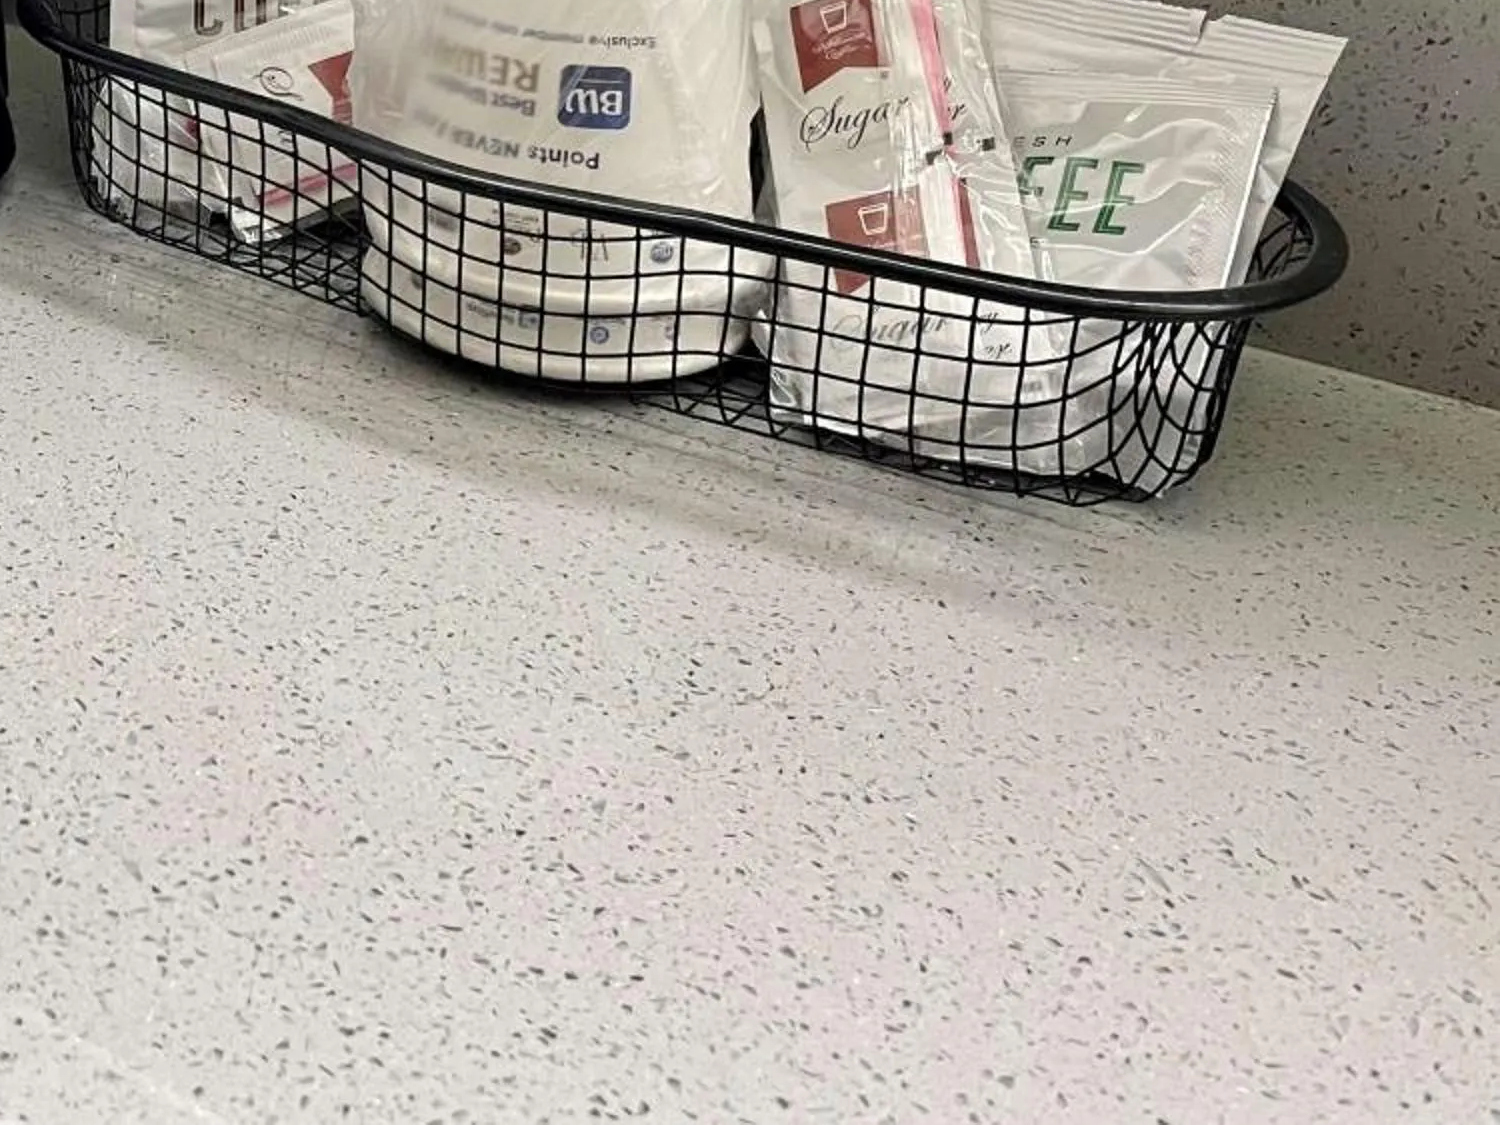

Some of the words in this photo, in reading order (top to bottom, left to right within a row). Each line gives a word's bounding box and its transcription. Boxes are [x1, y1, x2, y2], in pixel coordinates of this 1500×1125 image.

[565, 87, 624, 117] BW
[800, 94, 910, 154] Sugar
[527, 144, 601, 171] Points
